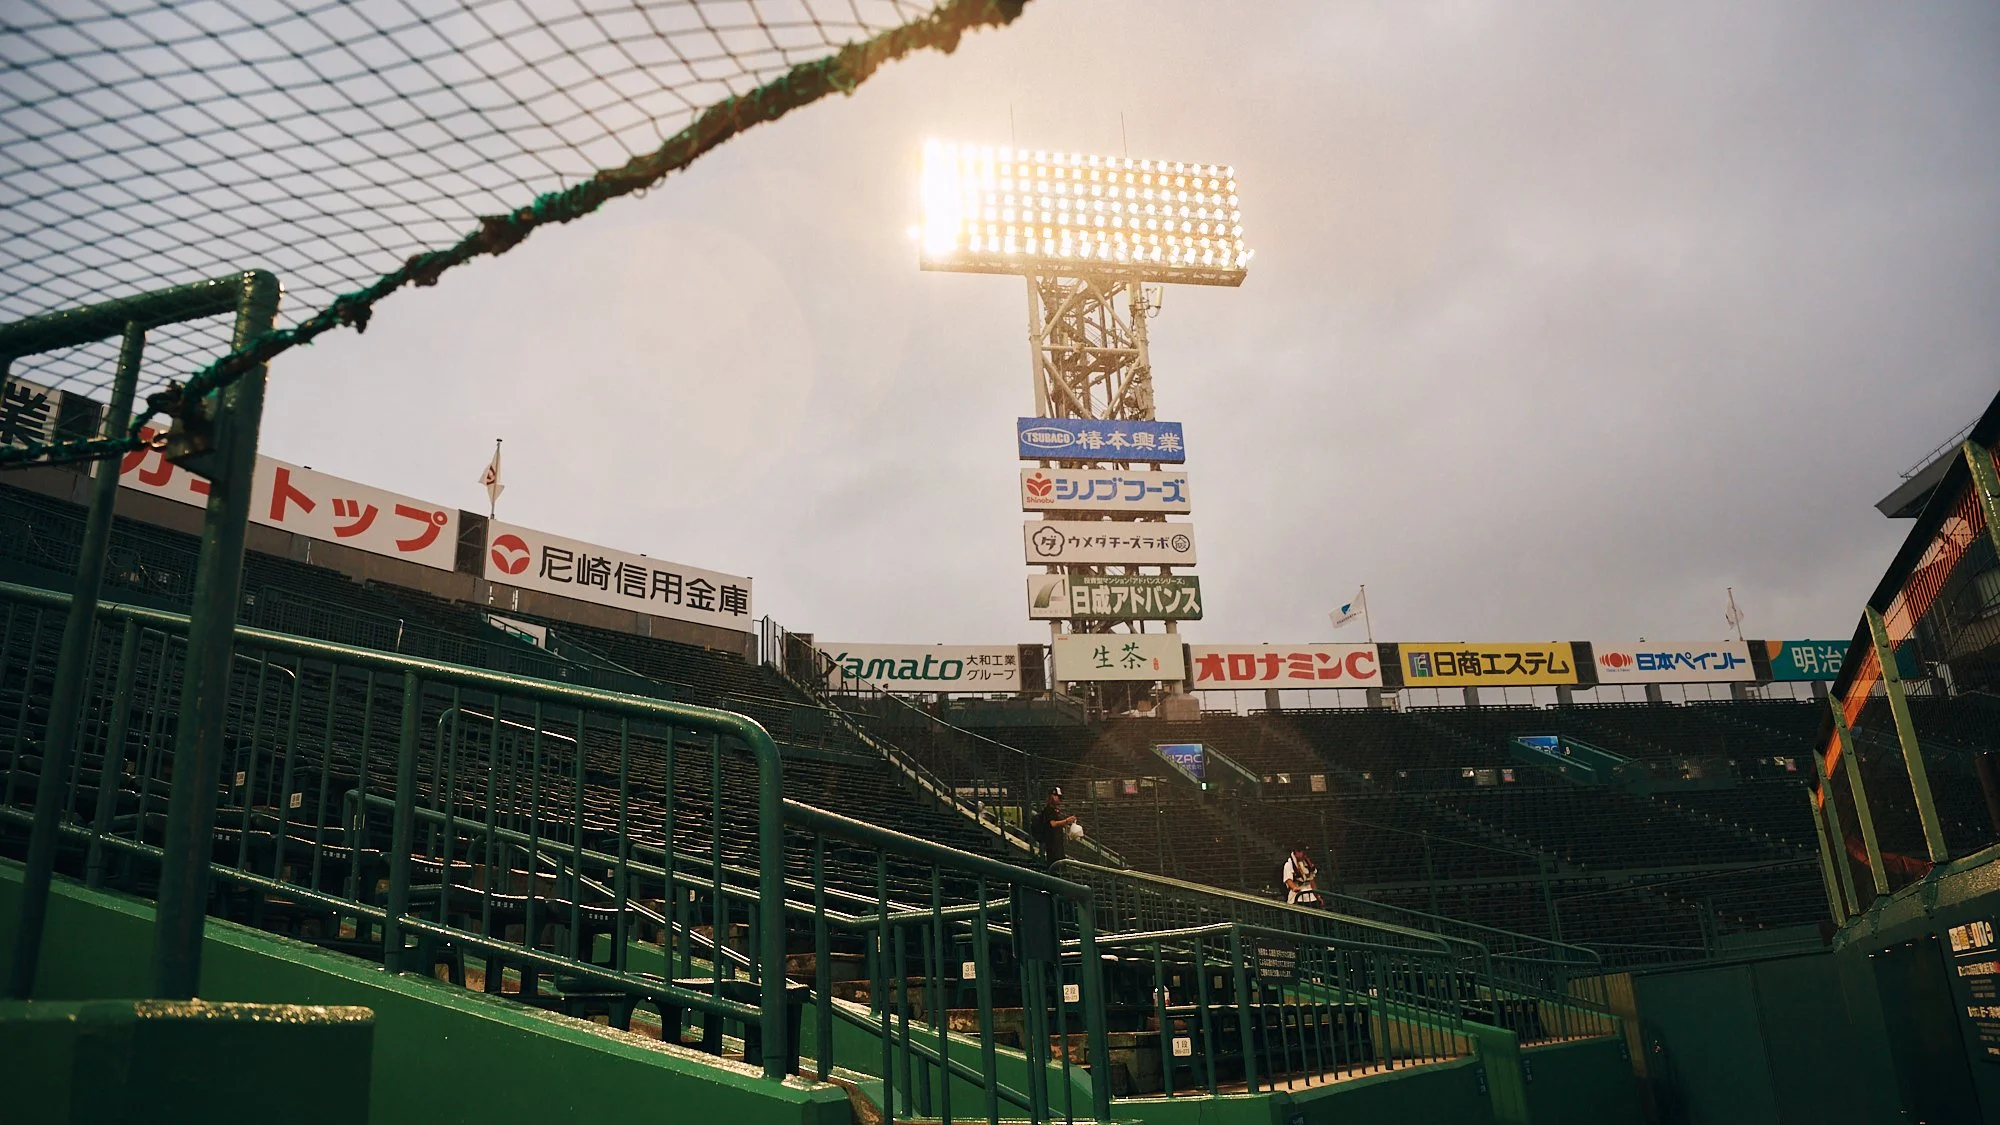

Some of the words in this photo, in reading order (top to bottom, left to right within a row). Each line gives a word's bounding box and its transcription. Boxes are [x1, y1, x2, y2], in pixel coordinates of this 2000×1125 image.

[1026, 432, 1071, 444] TSUBACO
[1076, 430, 1183, 453] 椿本興業
[1026, 496, 1055, 504] Shinobu
[1055, 477, 1186, 503] シノブフーズ
[1067, 534, 1170, 550] ウメダチーズラボ
[539, 545, 748, 617] 尼崎信用金庫
[1072, 585, 1201, 615] 日成アドバンス
[820, 649, 964, 681] Yamato
[966, 654, 1017, 667] 大和工業
[1092, 641, 1148, 670] 生茶
[1195, 651, 1377, 682] オロナミンC
[1434, 650, 1570, 677] 日商エステム
[1636, 651, 1747, 671] 日本ペイント
[1791, 646, 1848, 675] 明治
[966, 668, 1017, 681] グループ
